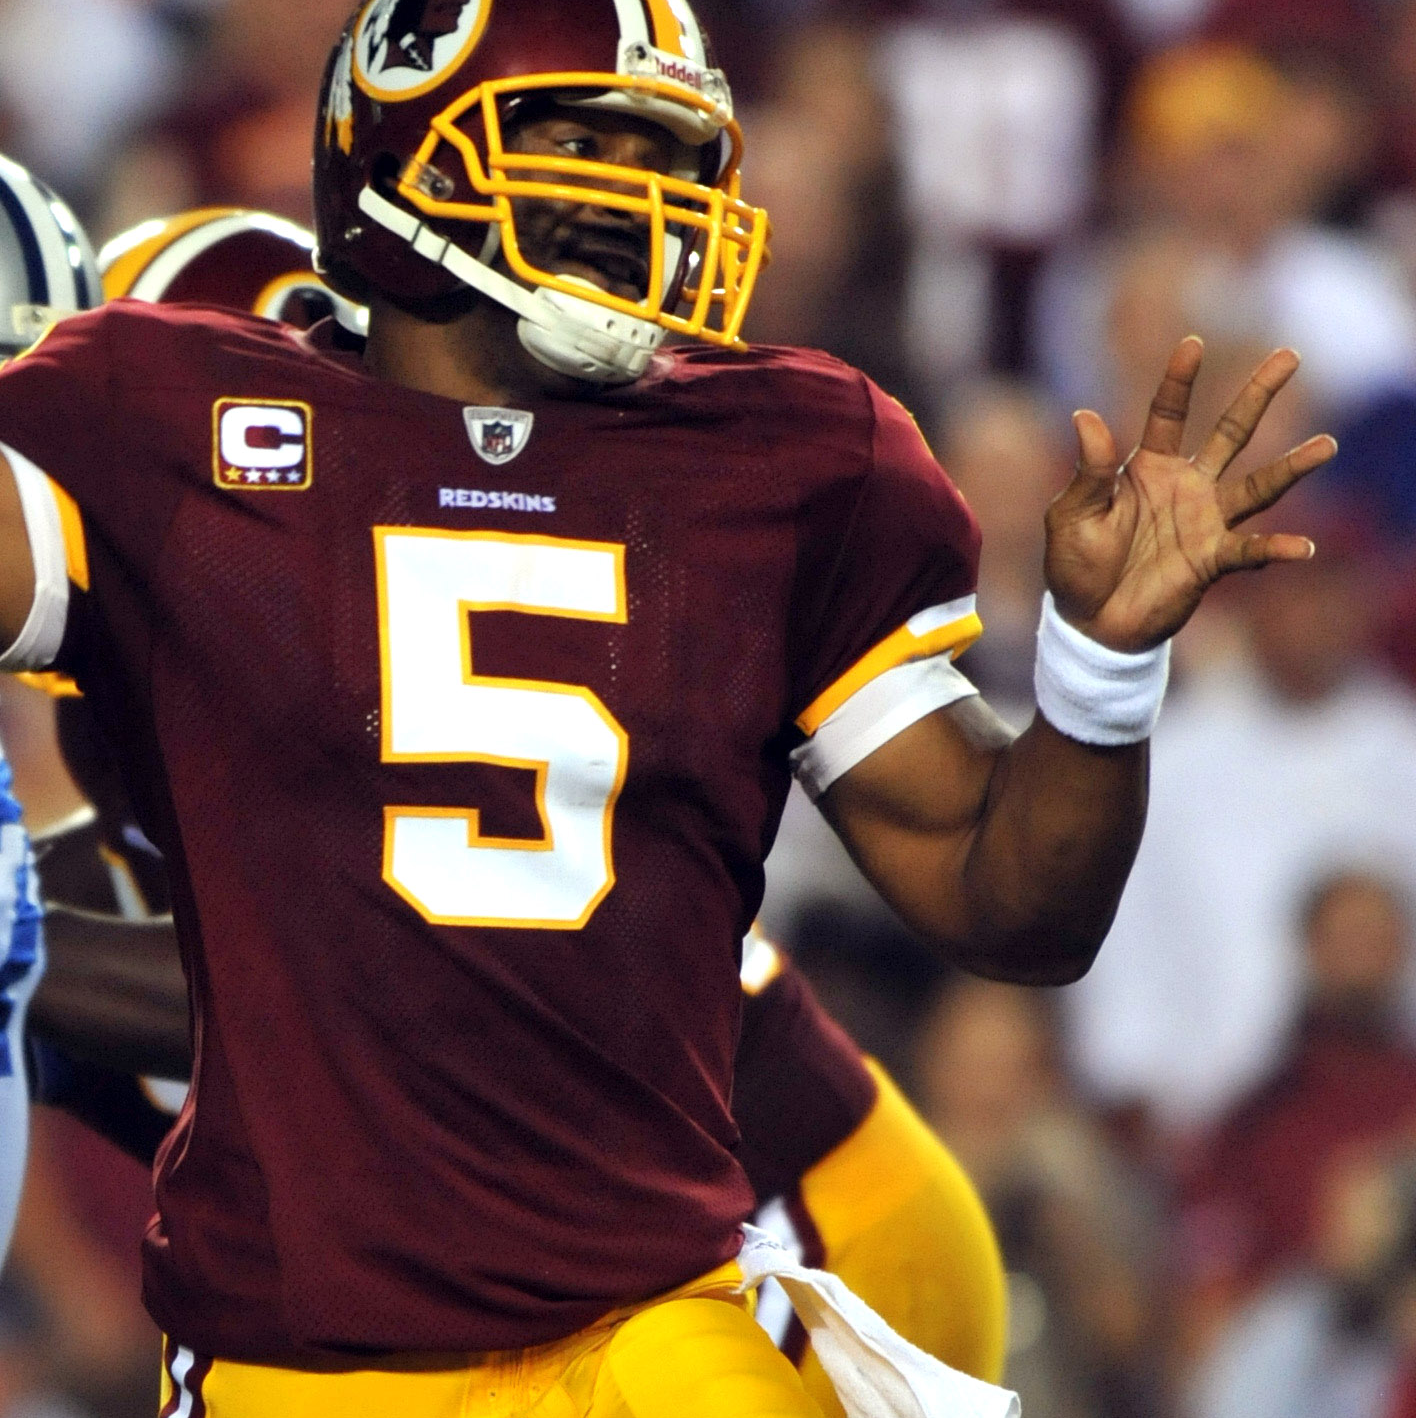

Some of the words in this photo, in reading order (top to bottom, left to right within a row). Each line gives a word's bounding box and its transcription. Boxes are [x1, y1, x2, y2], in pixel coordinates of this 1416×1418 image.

[655, 56, 701, 90] iddell
[221, 406, 304, 468] C
[439, 487, 557, 512] REDSKINS
[373, 526, 628, 930] 5
